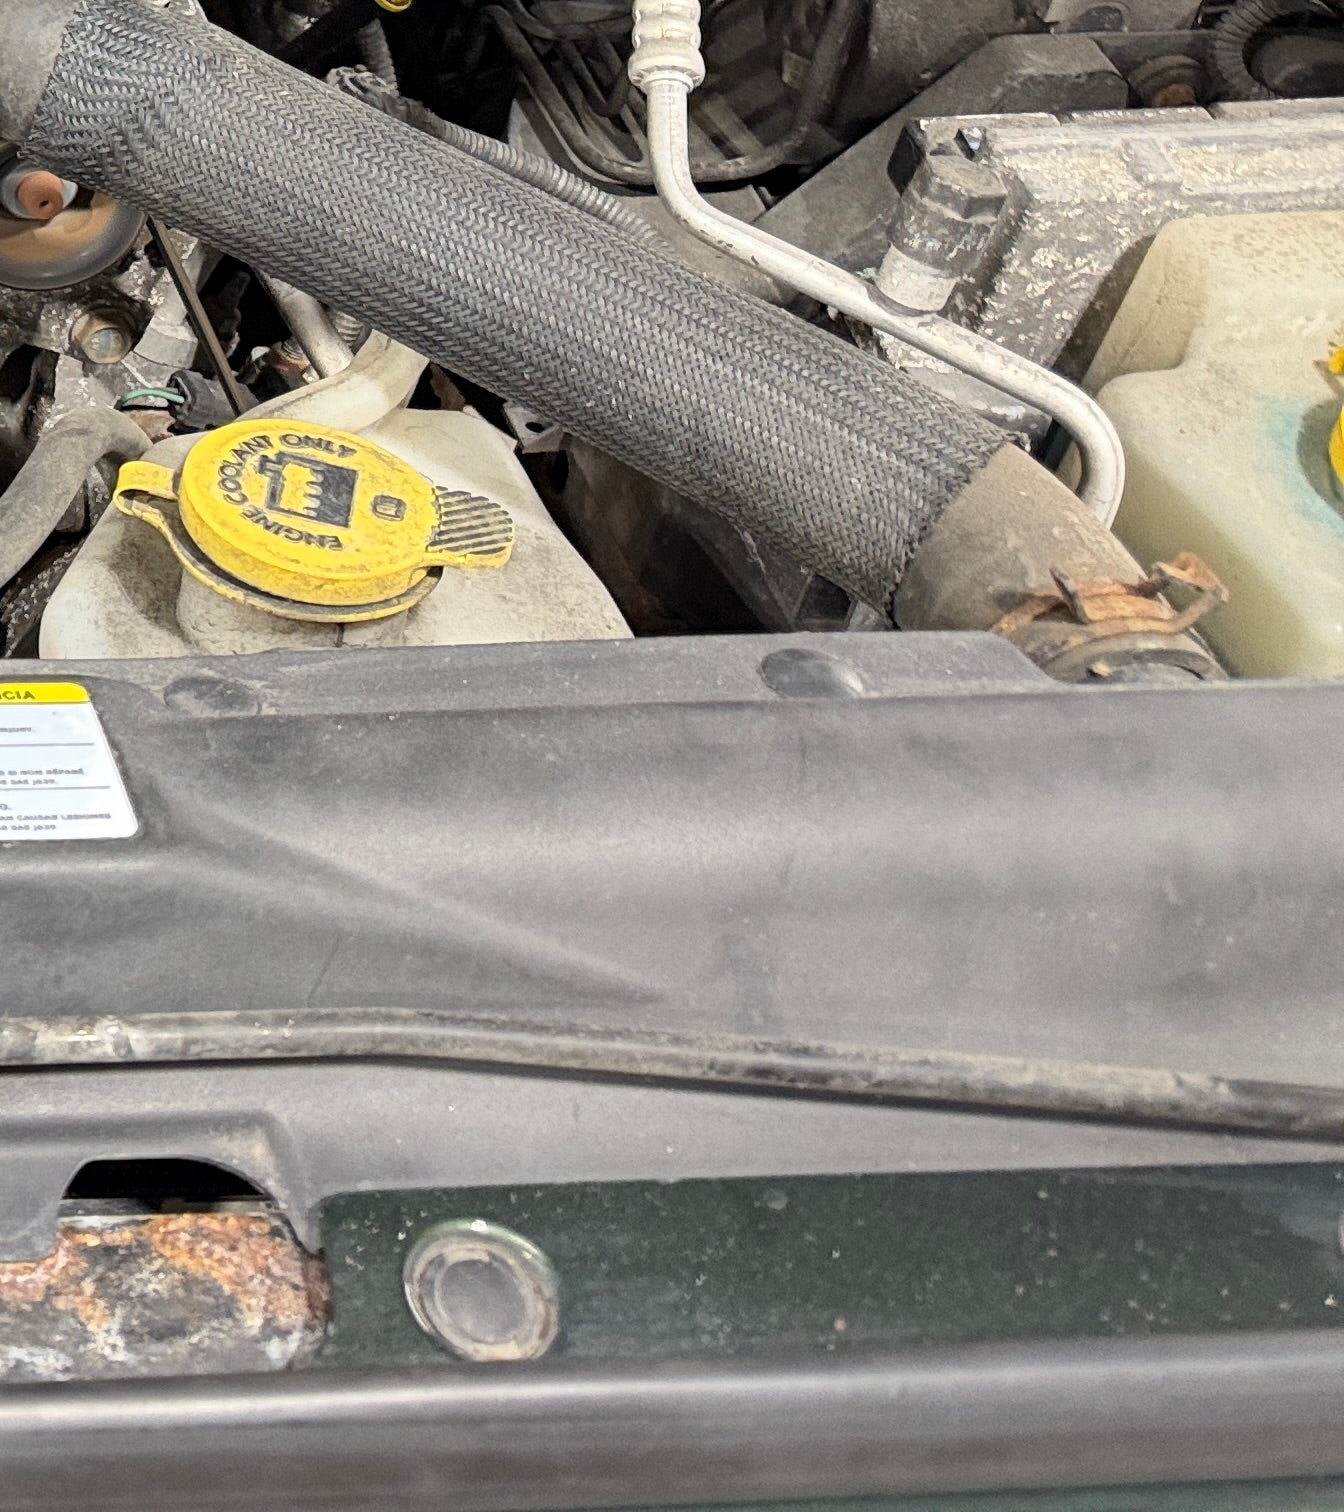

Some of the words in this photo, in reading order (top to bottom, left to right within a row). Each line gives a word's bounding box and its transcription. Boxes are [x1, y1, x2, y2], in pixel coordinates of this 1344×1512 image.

[279, 433, 358, 459] ONLY
[217, 435, 273, 506] COOLANT
[241, 508, 343, 552] ENGINE
